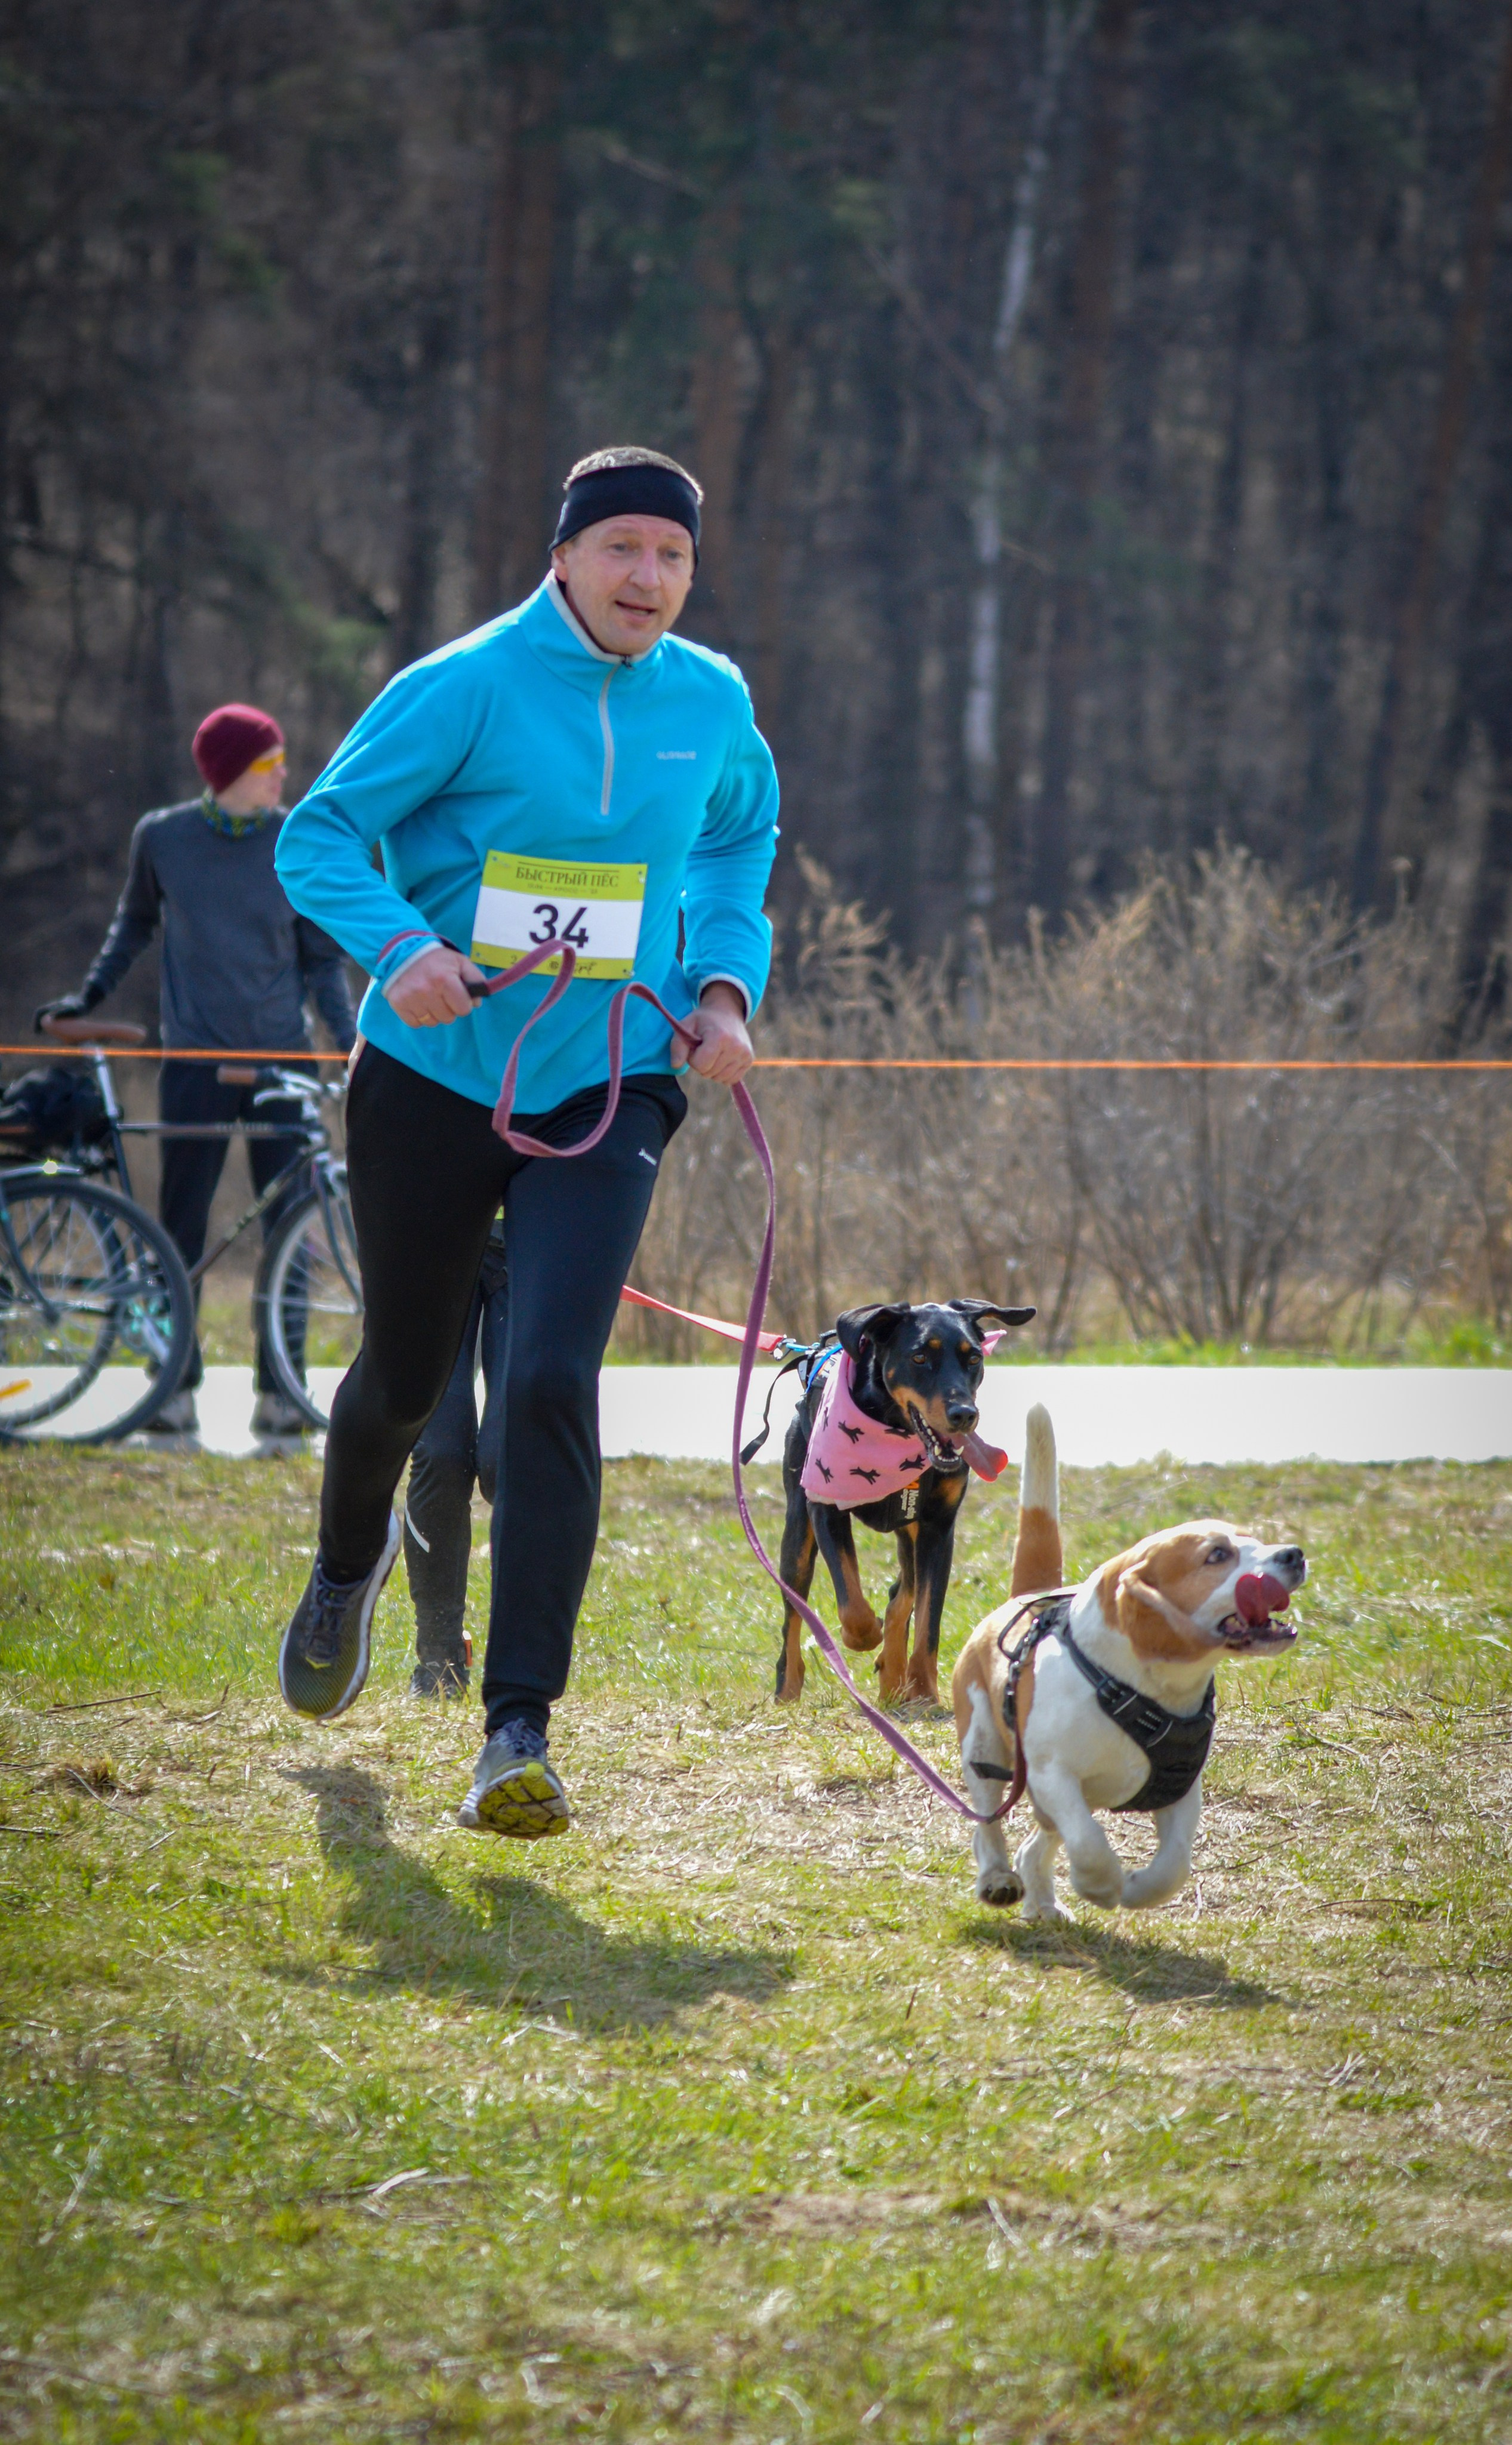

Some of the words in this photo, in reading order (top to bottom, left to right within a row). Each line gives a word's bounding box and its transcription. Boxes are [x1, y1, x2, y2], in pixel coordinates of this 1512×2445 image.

[516, 867, 587, 886] БЫСТРЫЙ
[591, 872, 619, 888] ПЁС
[529, 904, 589, 949] 34
